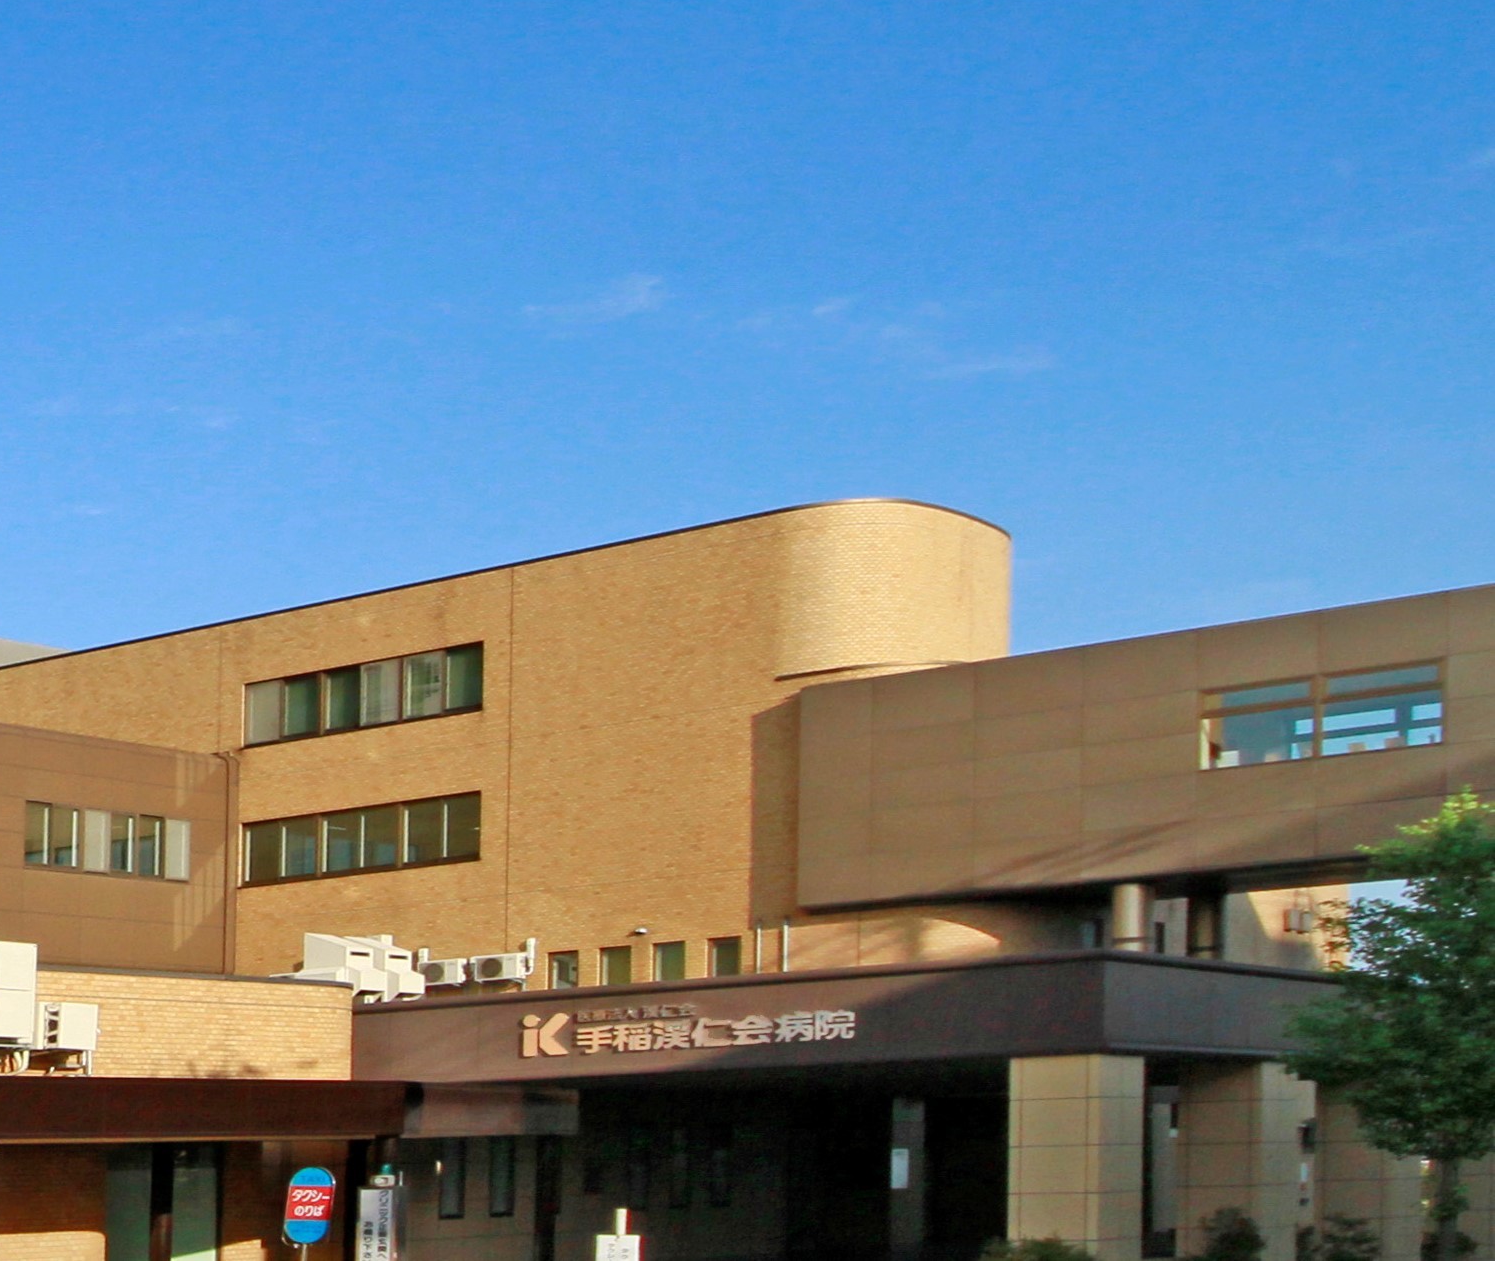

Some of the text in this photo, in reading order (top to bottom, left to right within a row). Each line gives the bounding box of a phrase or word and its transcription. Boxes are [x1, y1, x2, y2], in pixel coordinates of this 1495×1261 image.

[576, 1010, 856, 1053] 手稲渓仁会病院
[291, 1189, 331, 1202] タクシー
[294, 1205, 325, 1217] のりば
